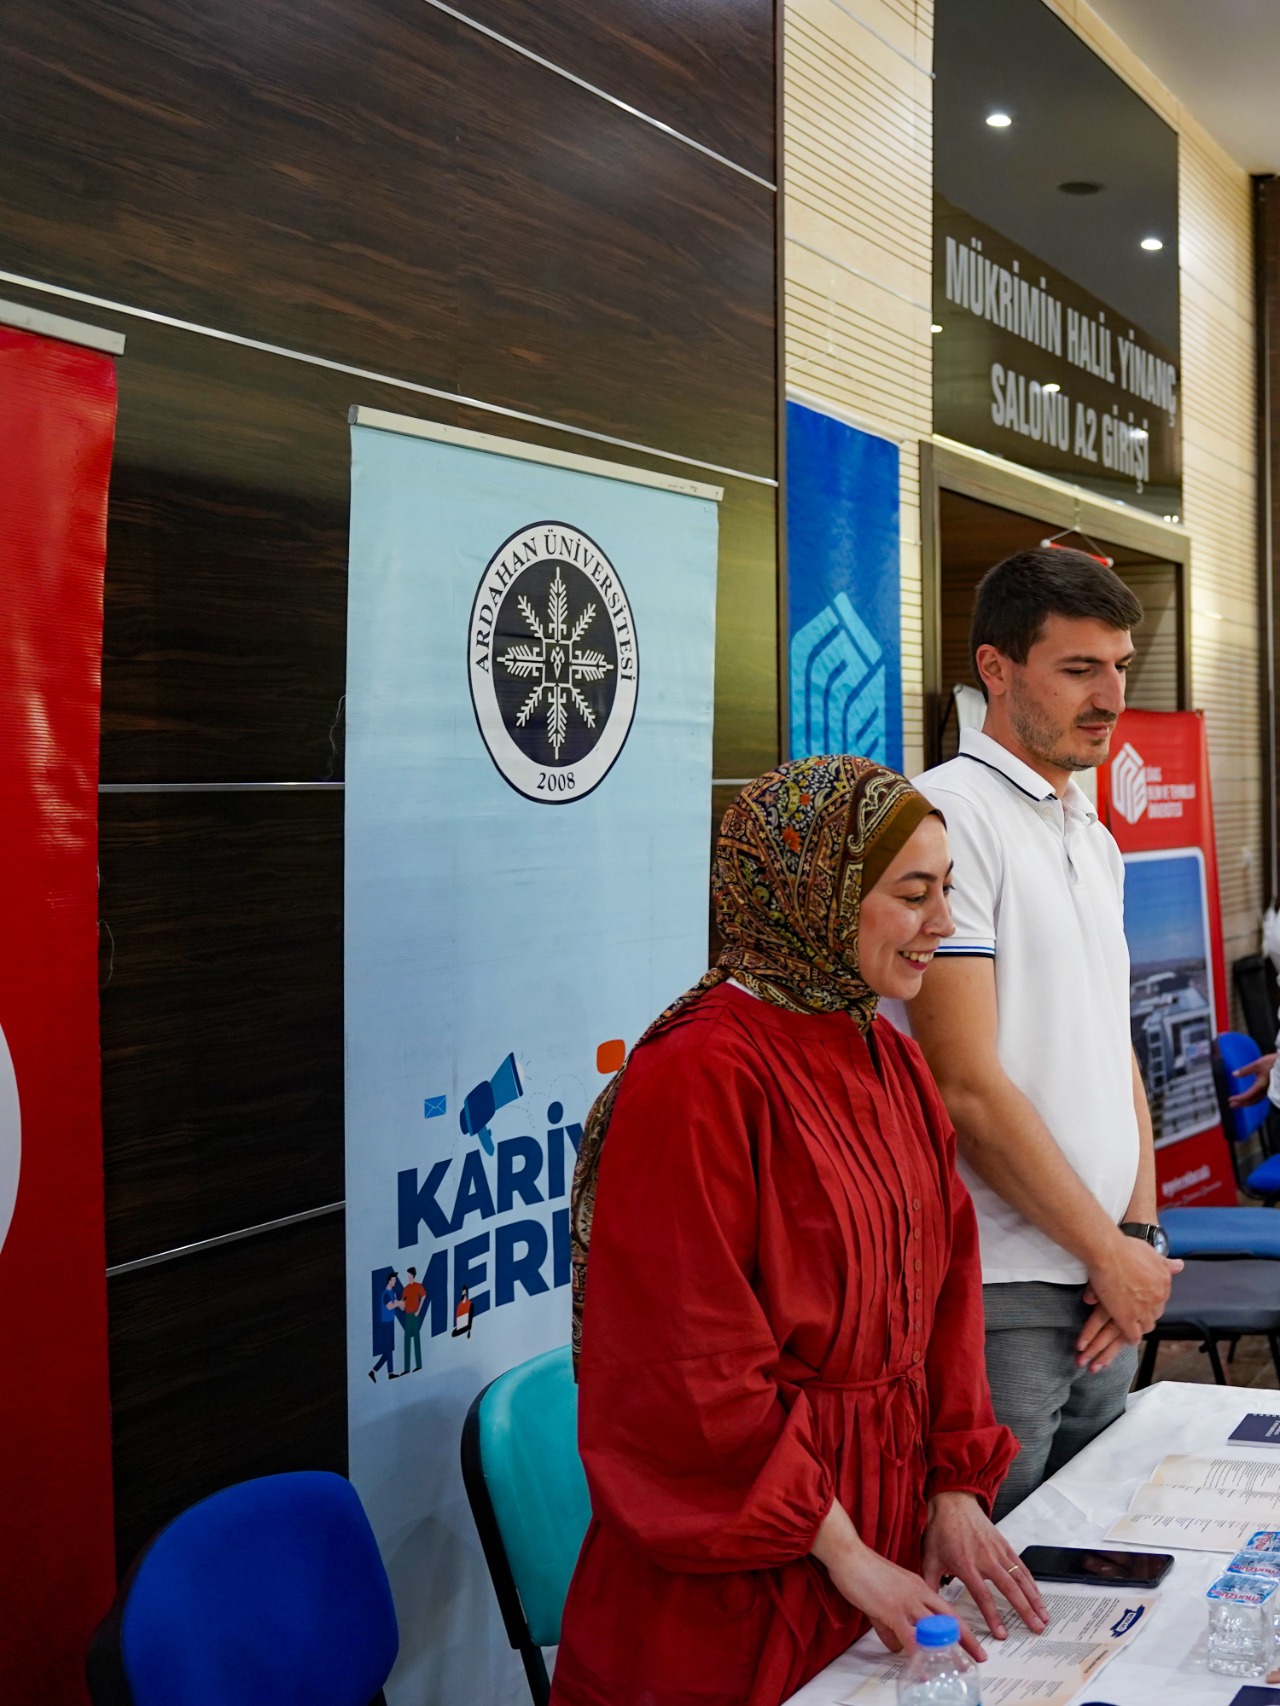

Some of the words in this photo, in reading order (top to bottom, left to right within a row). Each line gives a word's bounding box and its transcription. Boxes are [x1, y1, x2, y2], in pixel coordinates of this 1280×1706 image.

[946, 236, 1062, 357] MÜKRİMİN
[1067, 307, 1115, 384] HALİL
[1117, 329, 1177, 427] YİNANÇ
[991, 363, 1070, 452] SALONU
[1074, 402, 1098, 462] A2
[1102, 404, 1150, 494] GİRİŞİ
[475, 536, 538, 674] ARDAHAN
[543, 529, 637, 682] ÜNİVERSİTESİ
[536, 771, 576, 792] 2008
